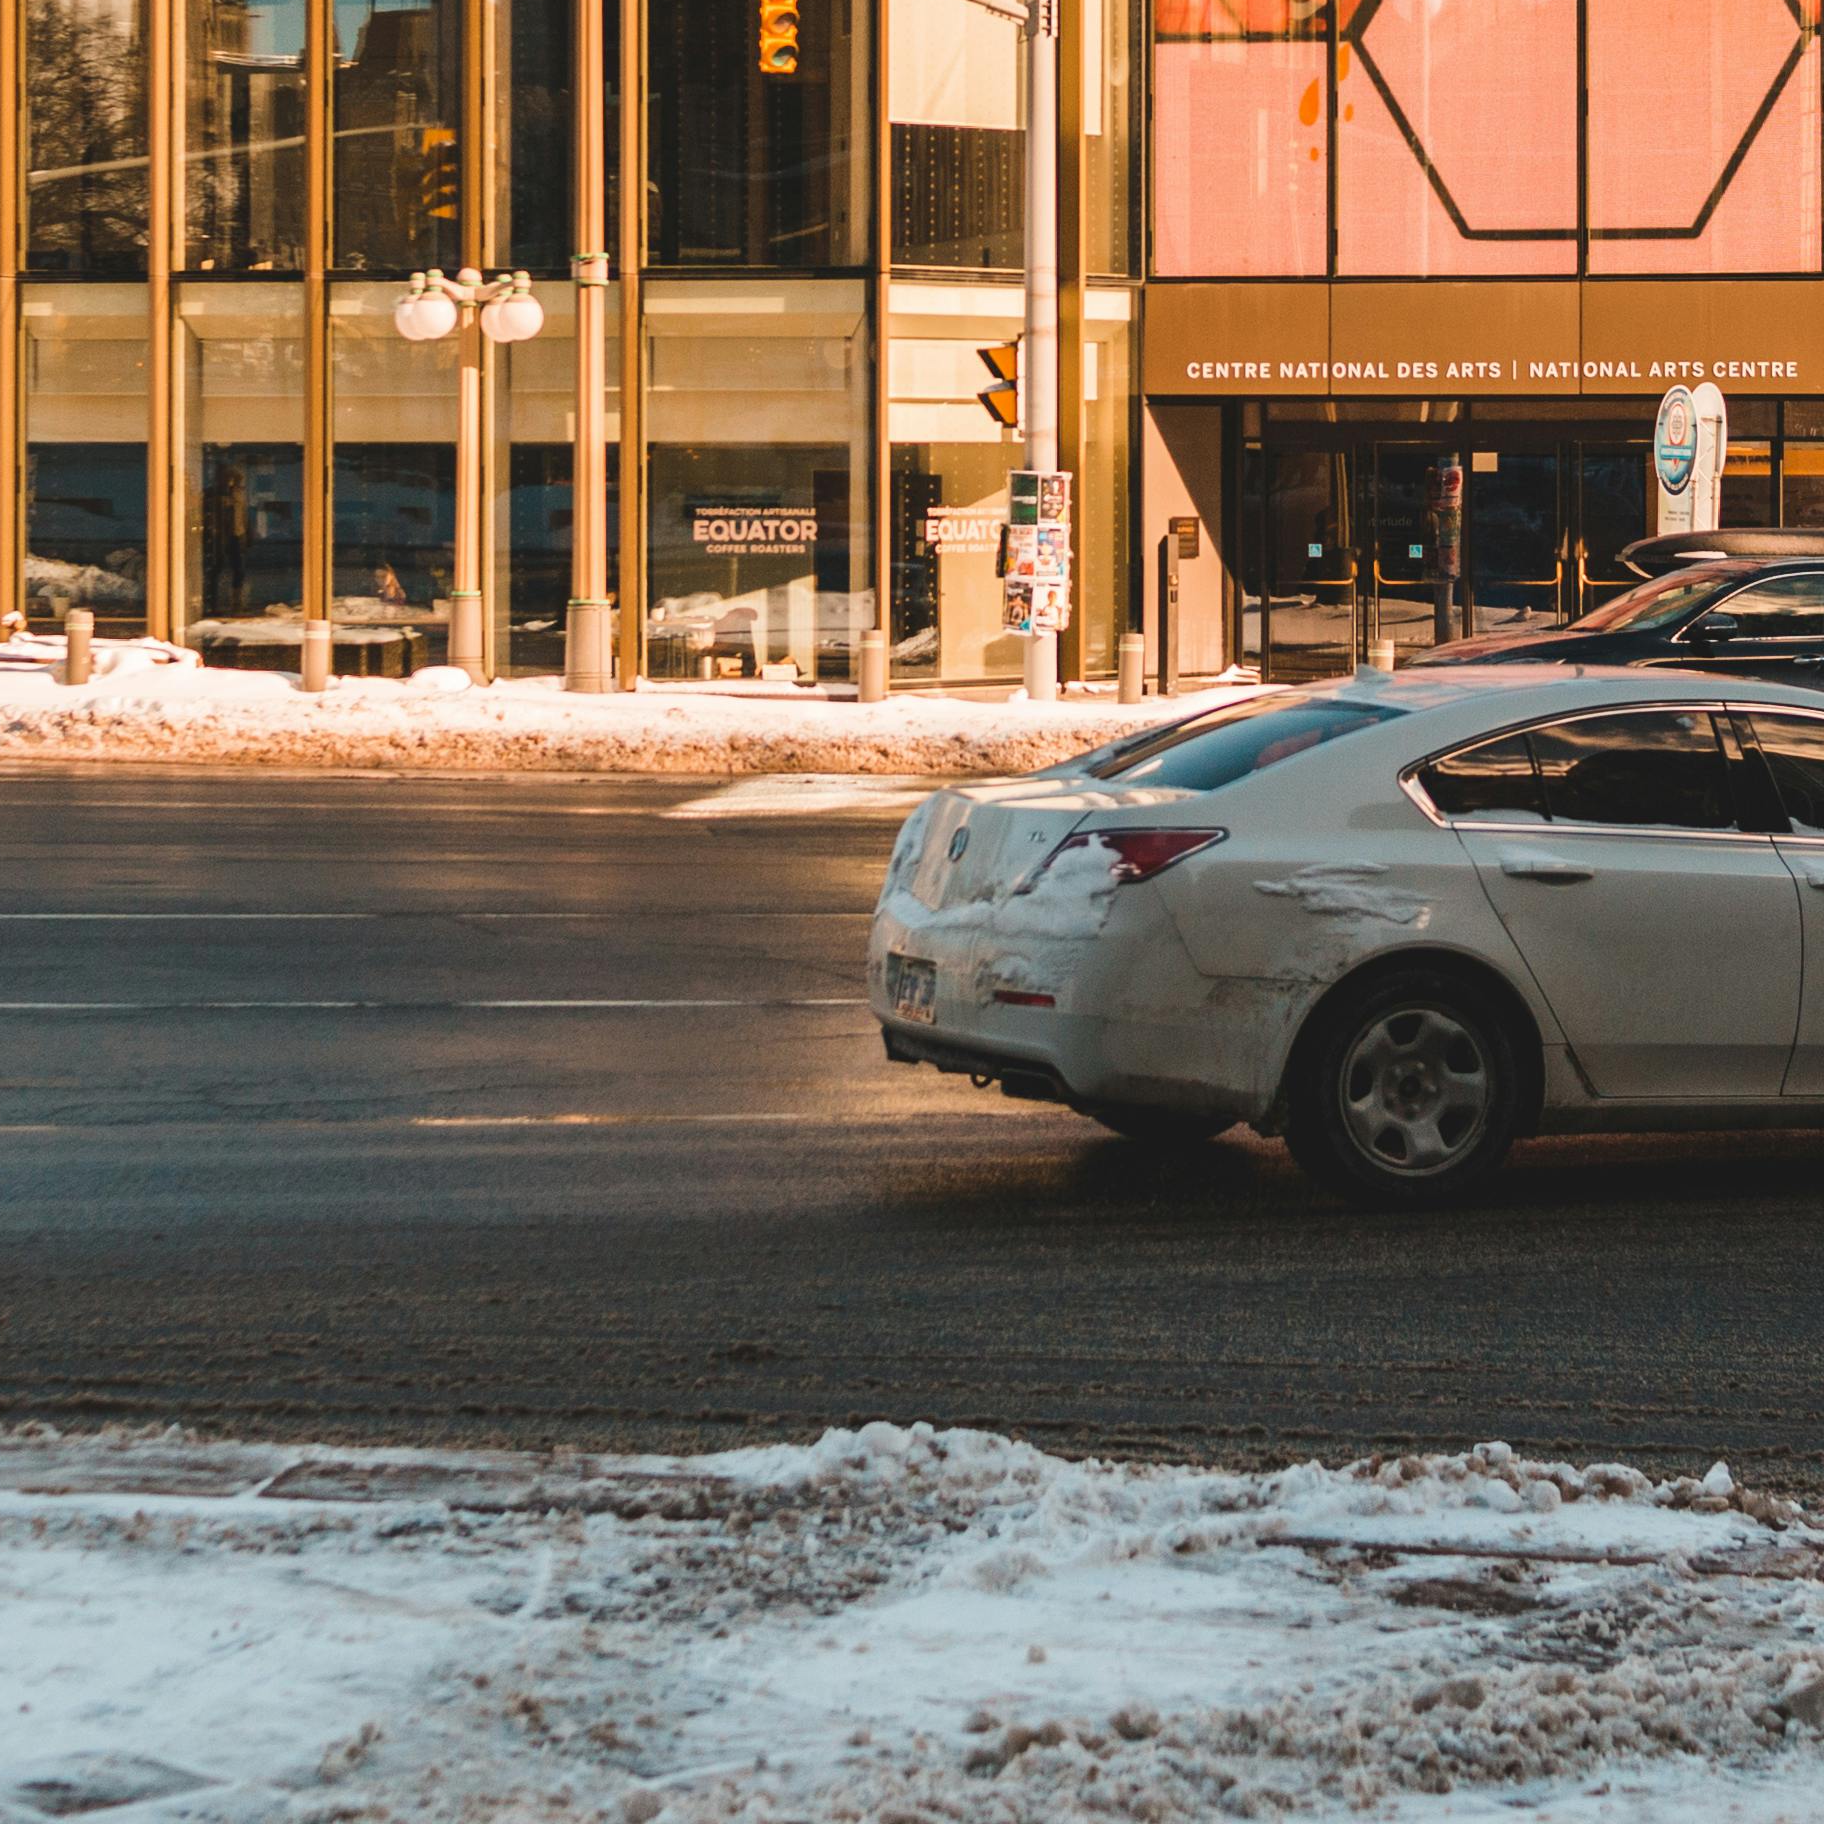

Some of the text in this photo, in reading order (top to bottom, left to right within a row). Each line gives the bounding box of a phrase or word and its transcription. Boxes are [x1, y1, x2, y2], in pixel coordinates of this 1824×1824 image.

[1186, 360, 1799, 379] CENTRE NATIONAL DES ARTS NATIONAL ARTS CENTRE
[693, 519, 818, 542] EQUATOR
[926, 519, 1003, 542] EQUATO
[706, 544, 806, 554] COFFEE ROASTERS
